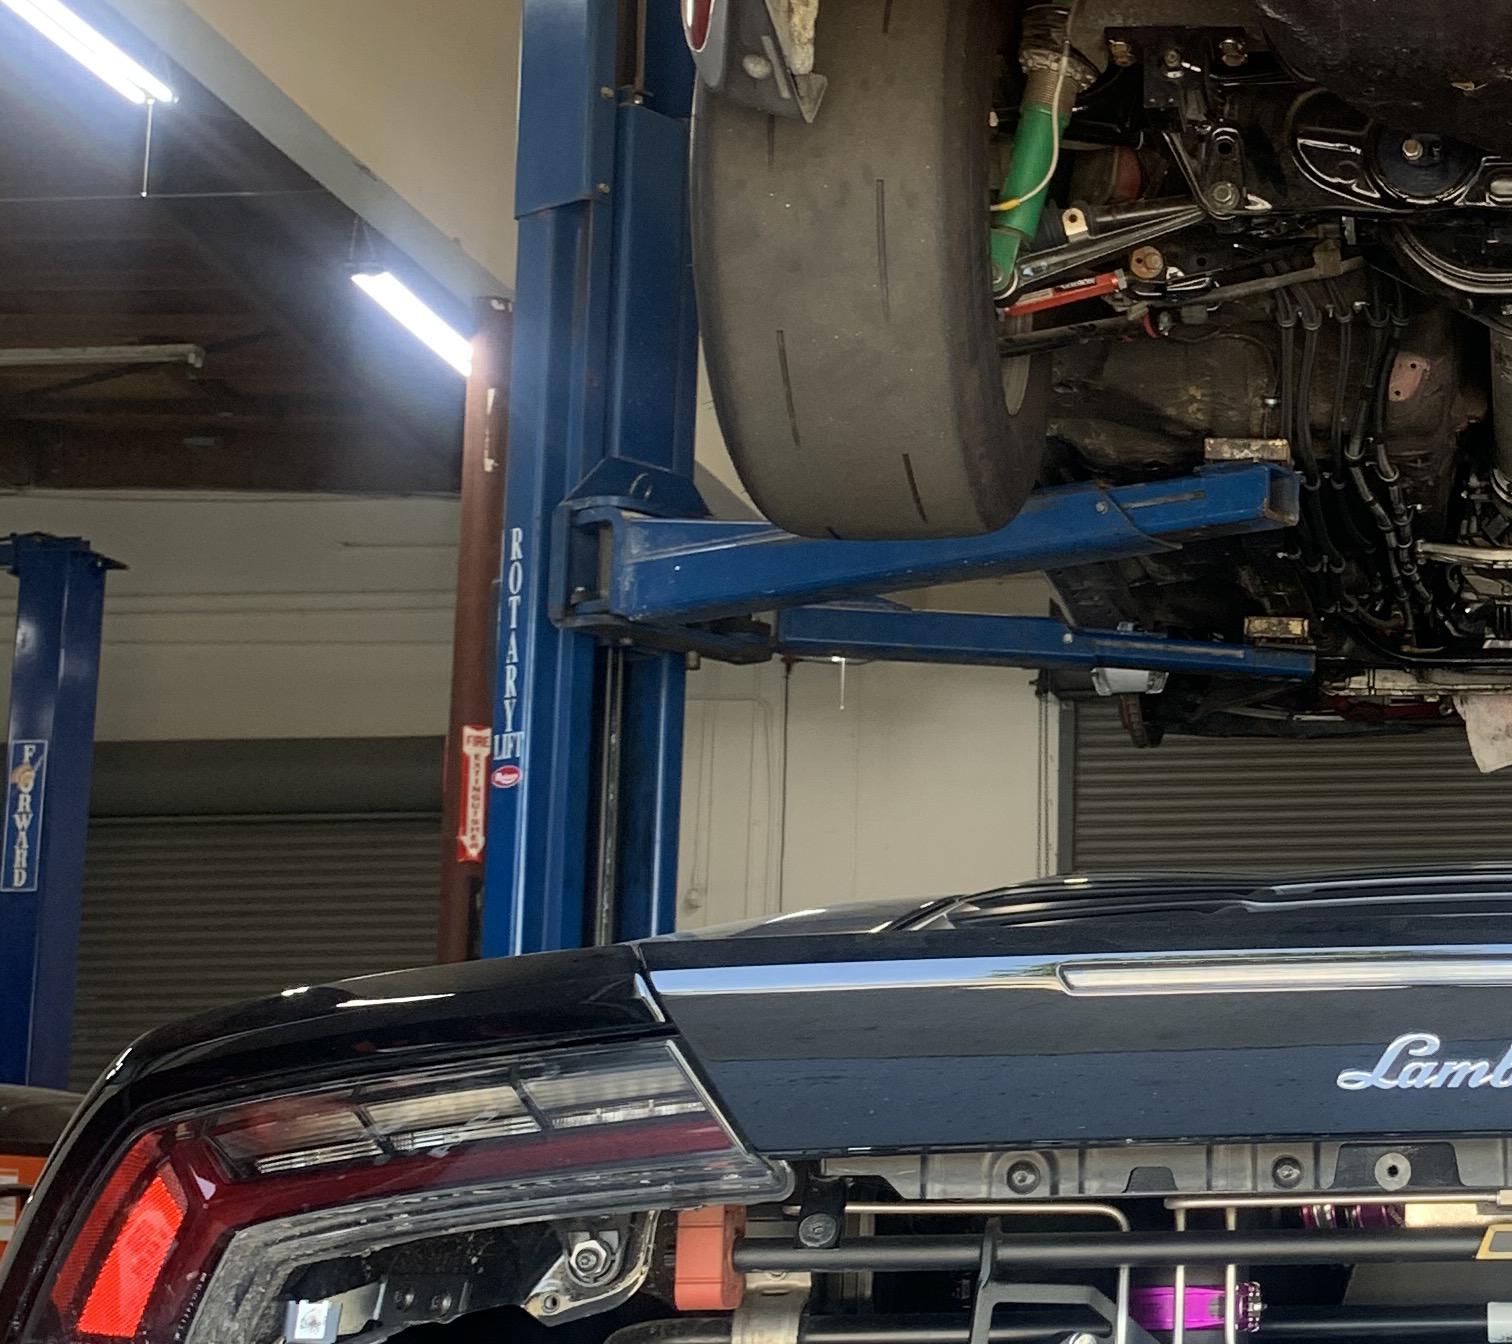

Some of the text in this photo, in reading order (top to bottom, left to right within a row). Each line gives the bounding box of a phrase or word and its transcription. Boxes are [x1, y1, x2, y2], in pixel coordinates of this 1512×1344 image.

[504, 527, 524, 734] ROTARY
[465, 734, 490, 748] FIRE
[493, 731, 525, 761] LIFT
[471, 753, 482, 850] EXTINGUISHER
